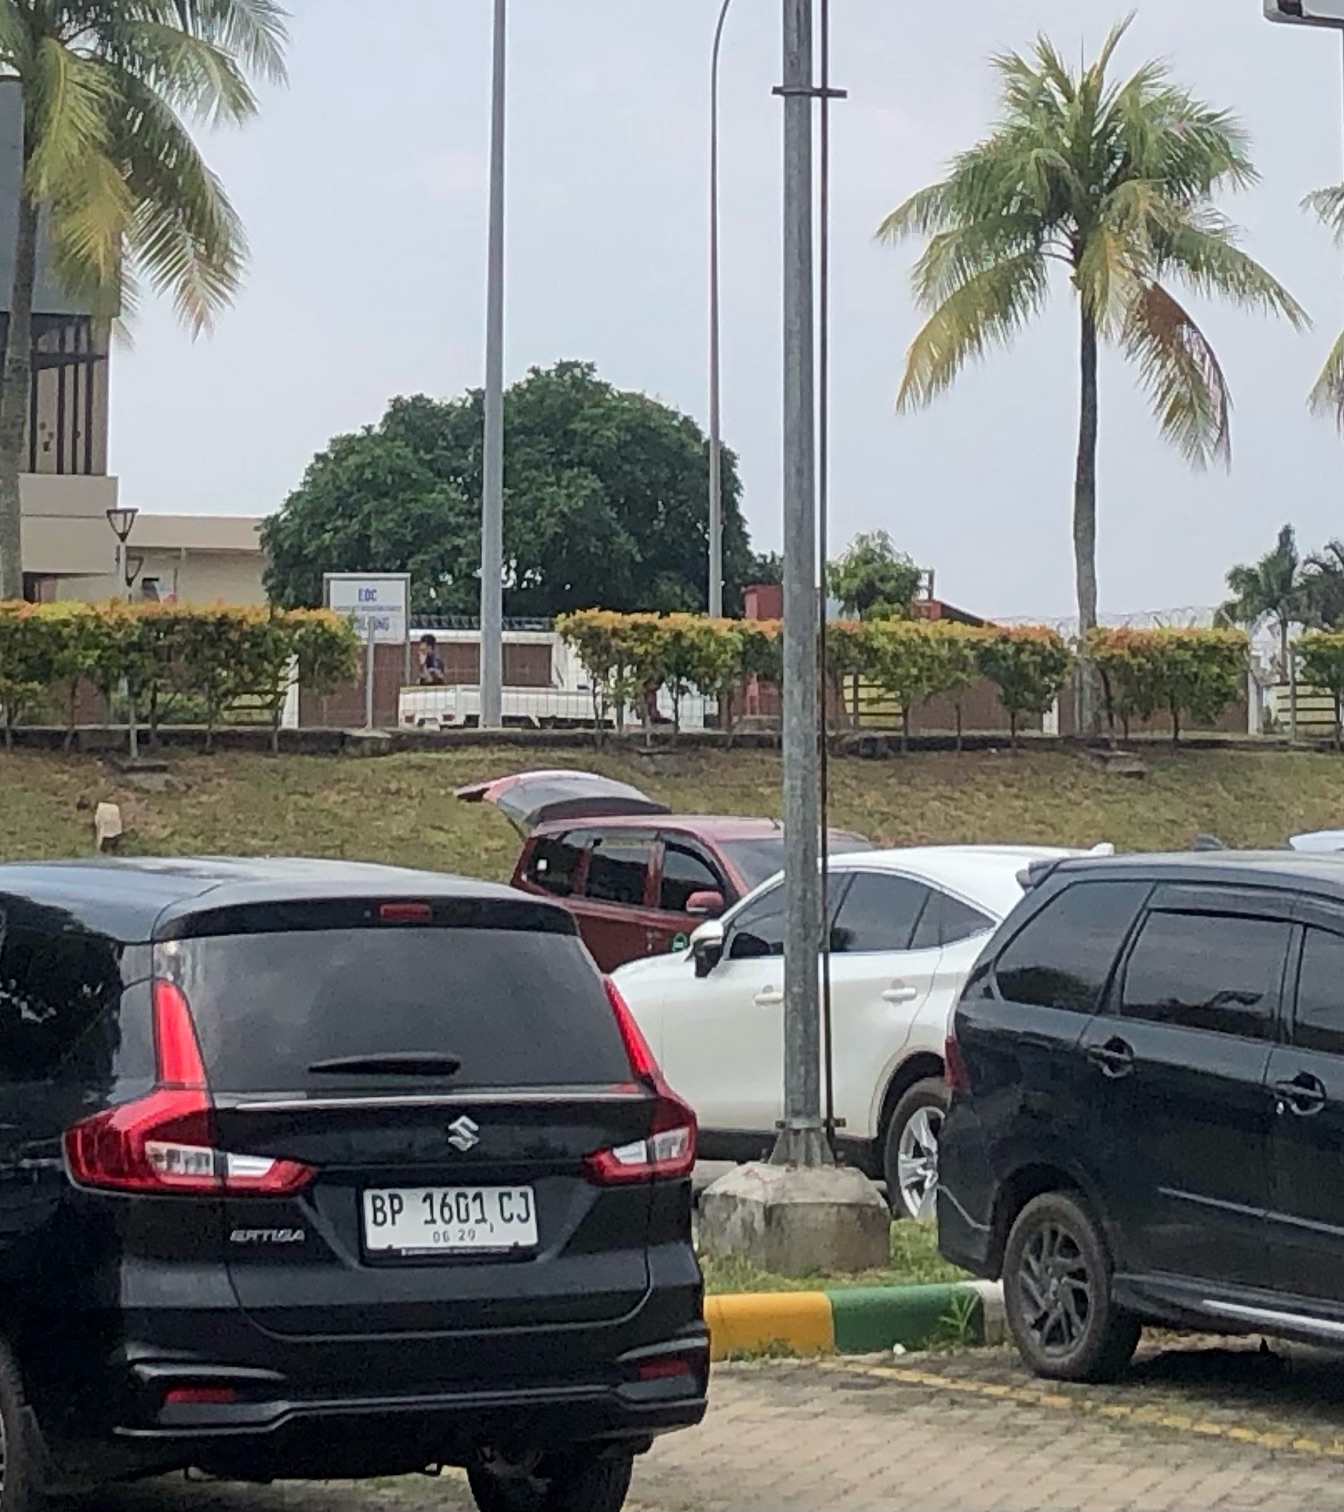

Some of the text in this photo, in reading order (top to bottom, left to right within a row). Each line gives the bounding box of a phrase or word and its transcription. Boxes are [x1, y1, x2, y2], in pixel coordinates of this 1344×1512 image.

[371, 1191, 531, 1227] BP 1601 CJ
